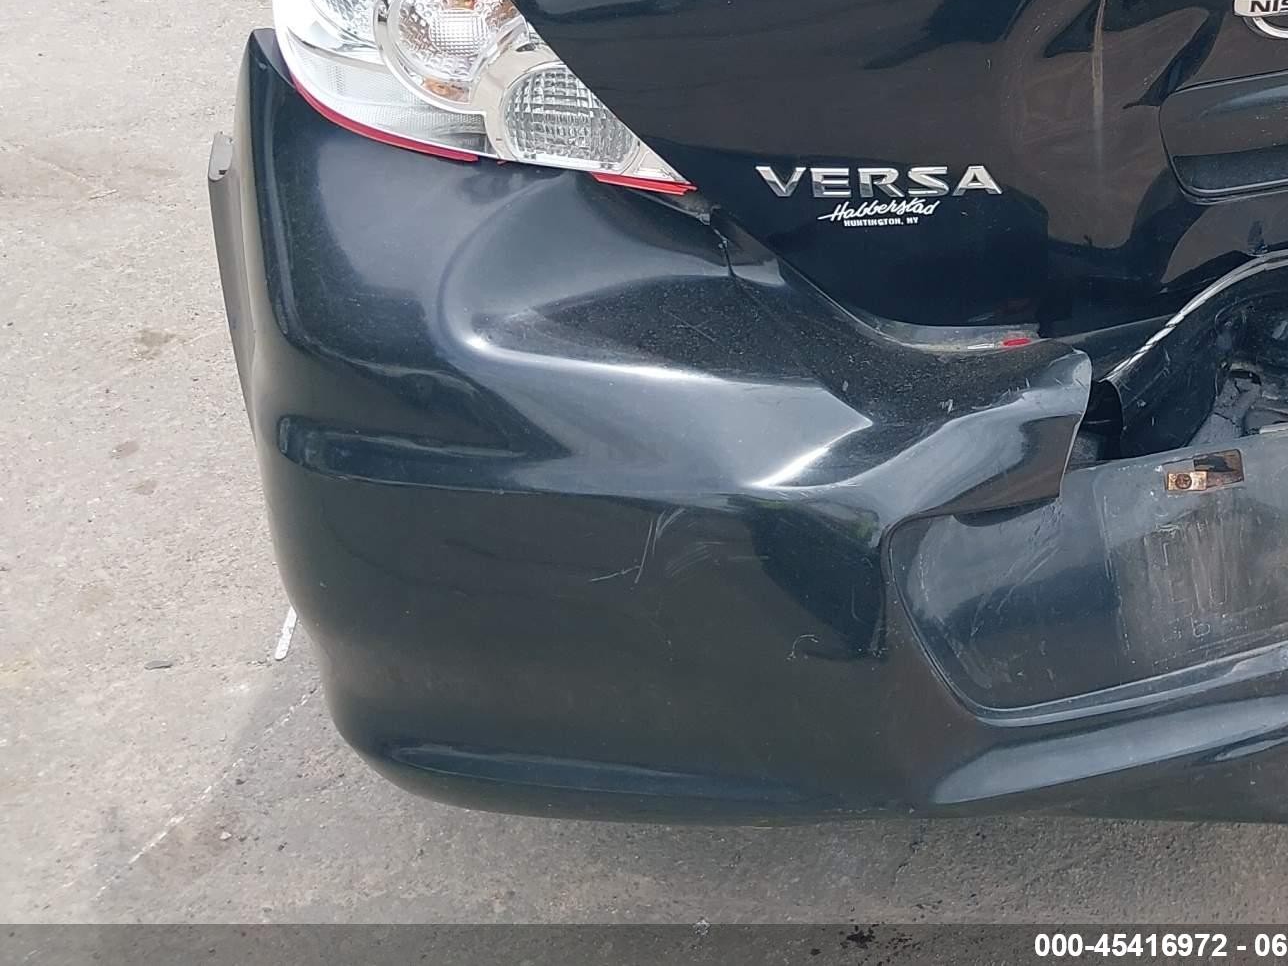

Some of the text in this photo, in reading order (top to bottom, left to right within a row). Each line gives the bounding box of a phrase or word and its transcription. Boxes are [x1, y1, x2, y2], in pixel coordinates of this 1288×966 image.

[755, 165, 1002, 198] VERSA
[817, 197, 940, 222] Habberstad
[843, 216, 919, 227] HUNTINGTON, NY
